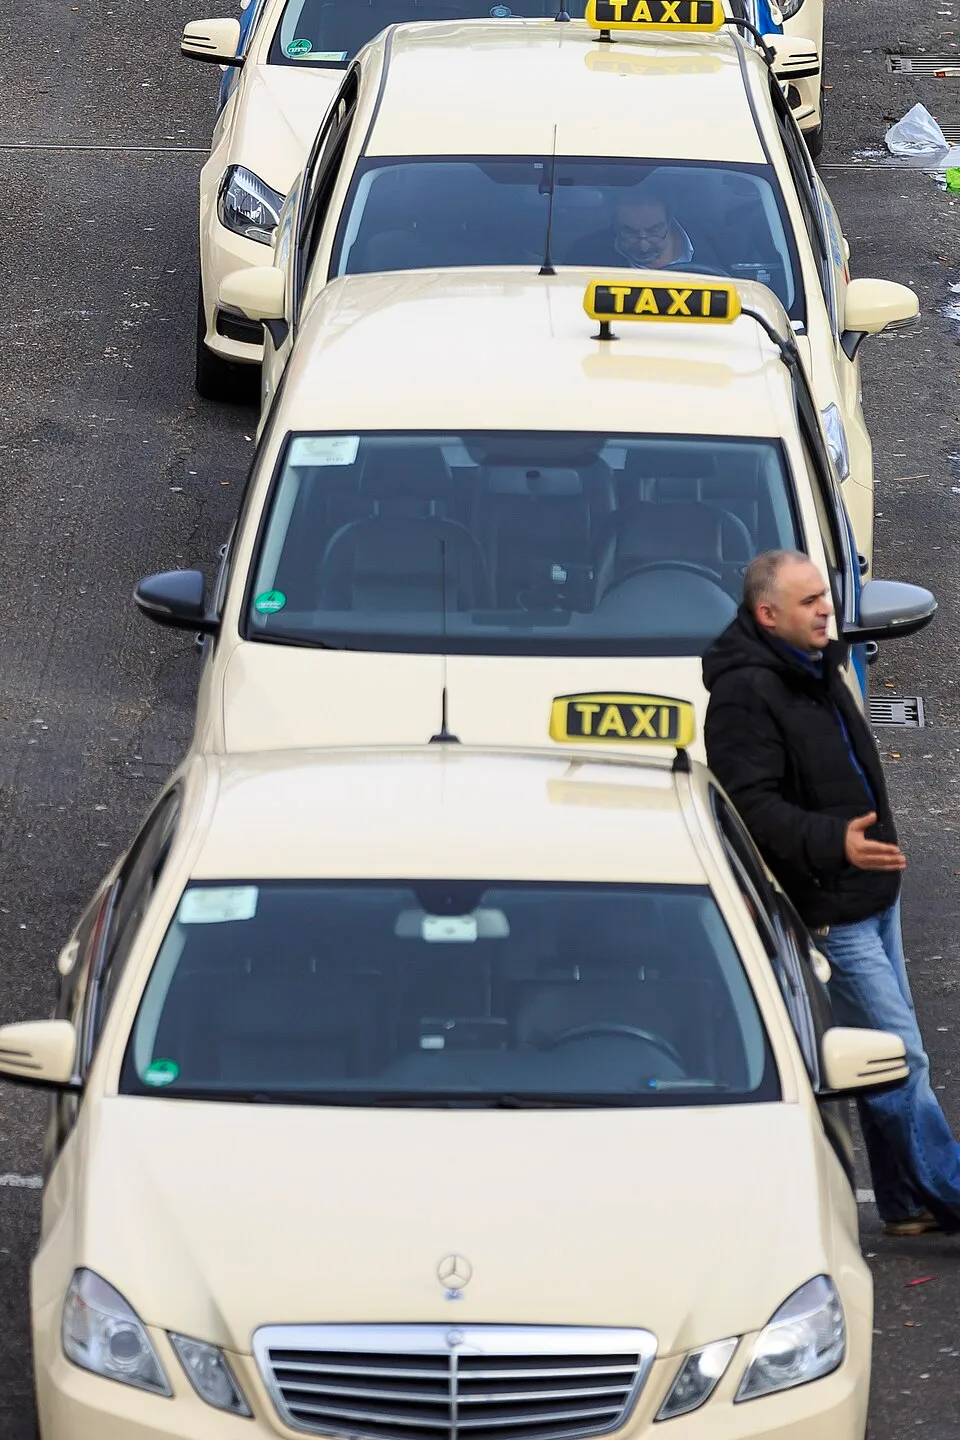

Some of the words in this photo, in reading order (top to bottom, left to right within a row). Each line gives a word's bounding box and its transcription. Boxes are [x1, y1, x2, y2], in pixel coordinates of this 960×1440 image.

[609, 0, 698, 23] TAXI
[610, 287, 711, 316] TAXI
[574, 704, 670, 739] TAXI
